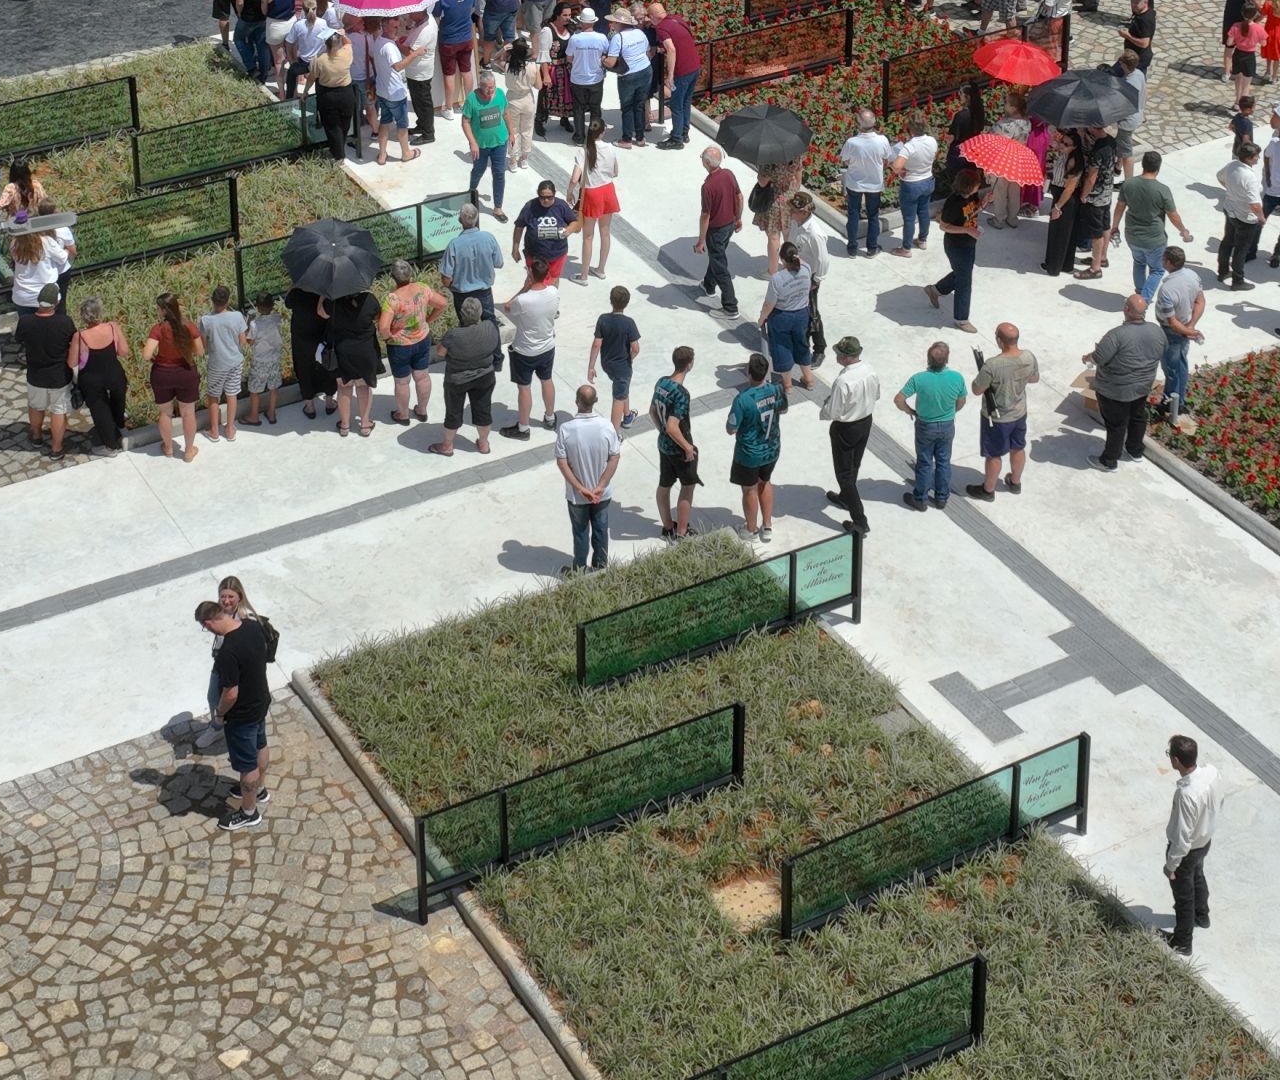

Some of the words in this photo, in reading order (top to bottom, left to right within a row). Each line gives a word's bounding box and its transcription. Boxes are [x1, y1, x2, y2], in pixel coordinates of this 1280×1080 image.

[761, 409, 774, 440] 7
[803, 554, 846, 572] Travessia
[801, 573, 844, 591] Atlântico
